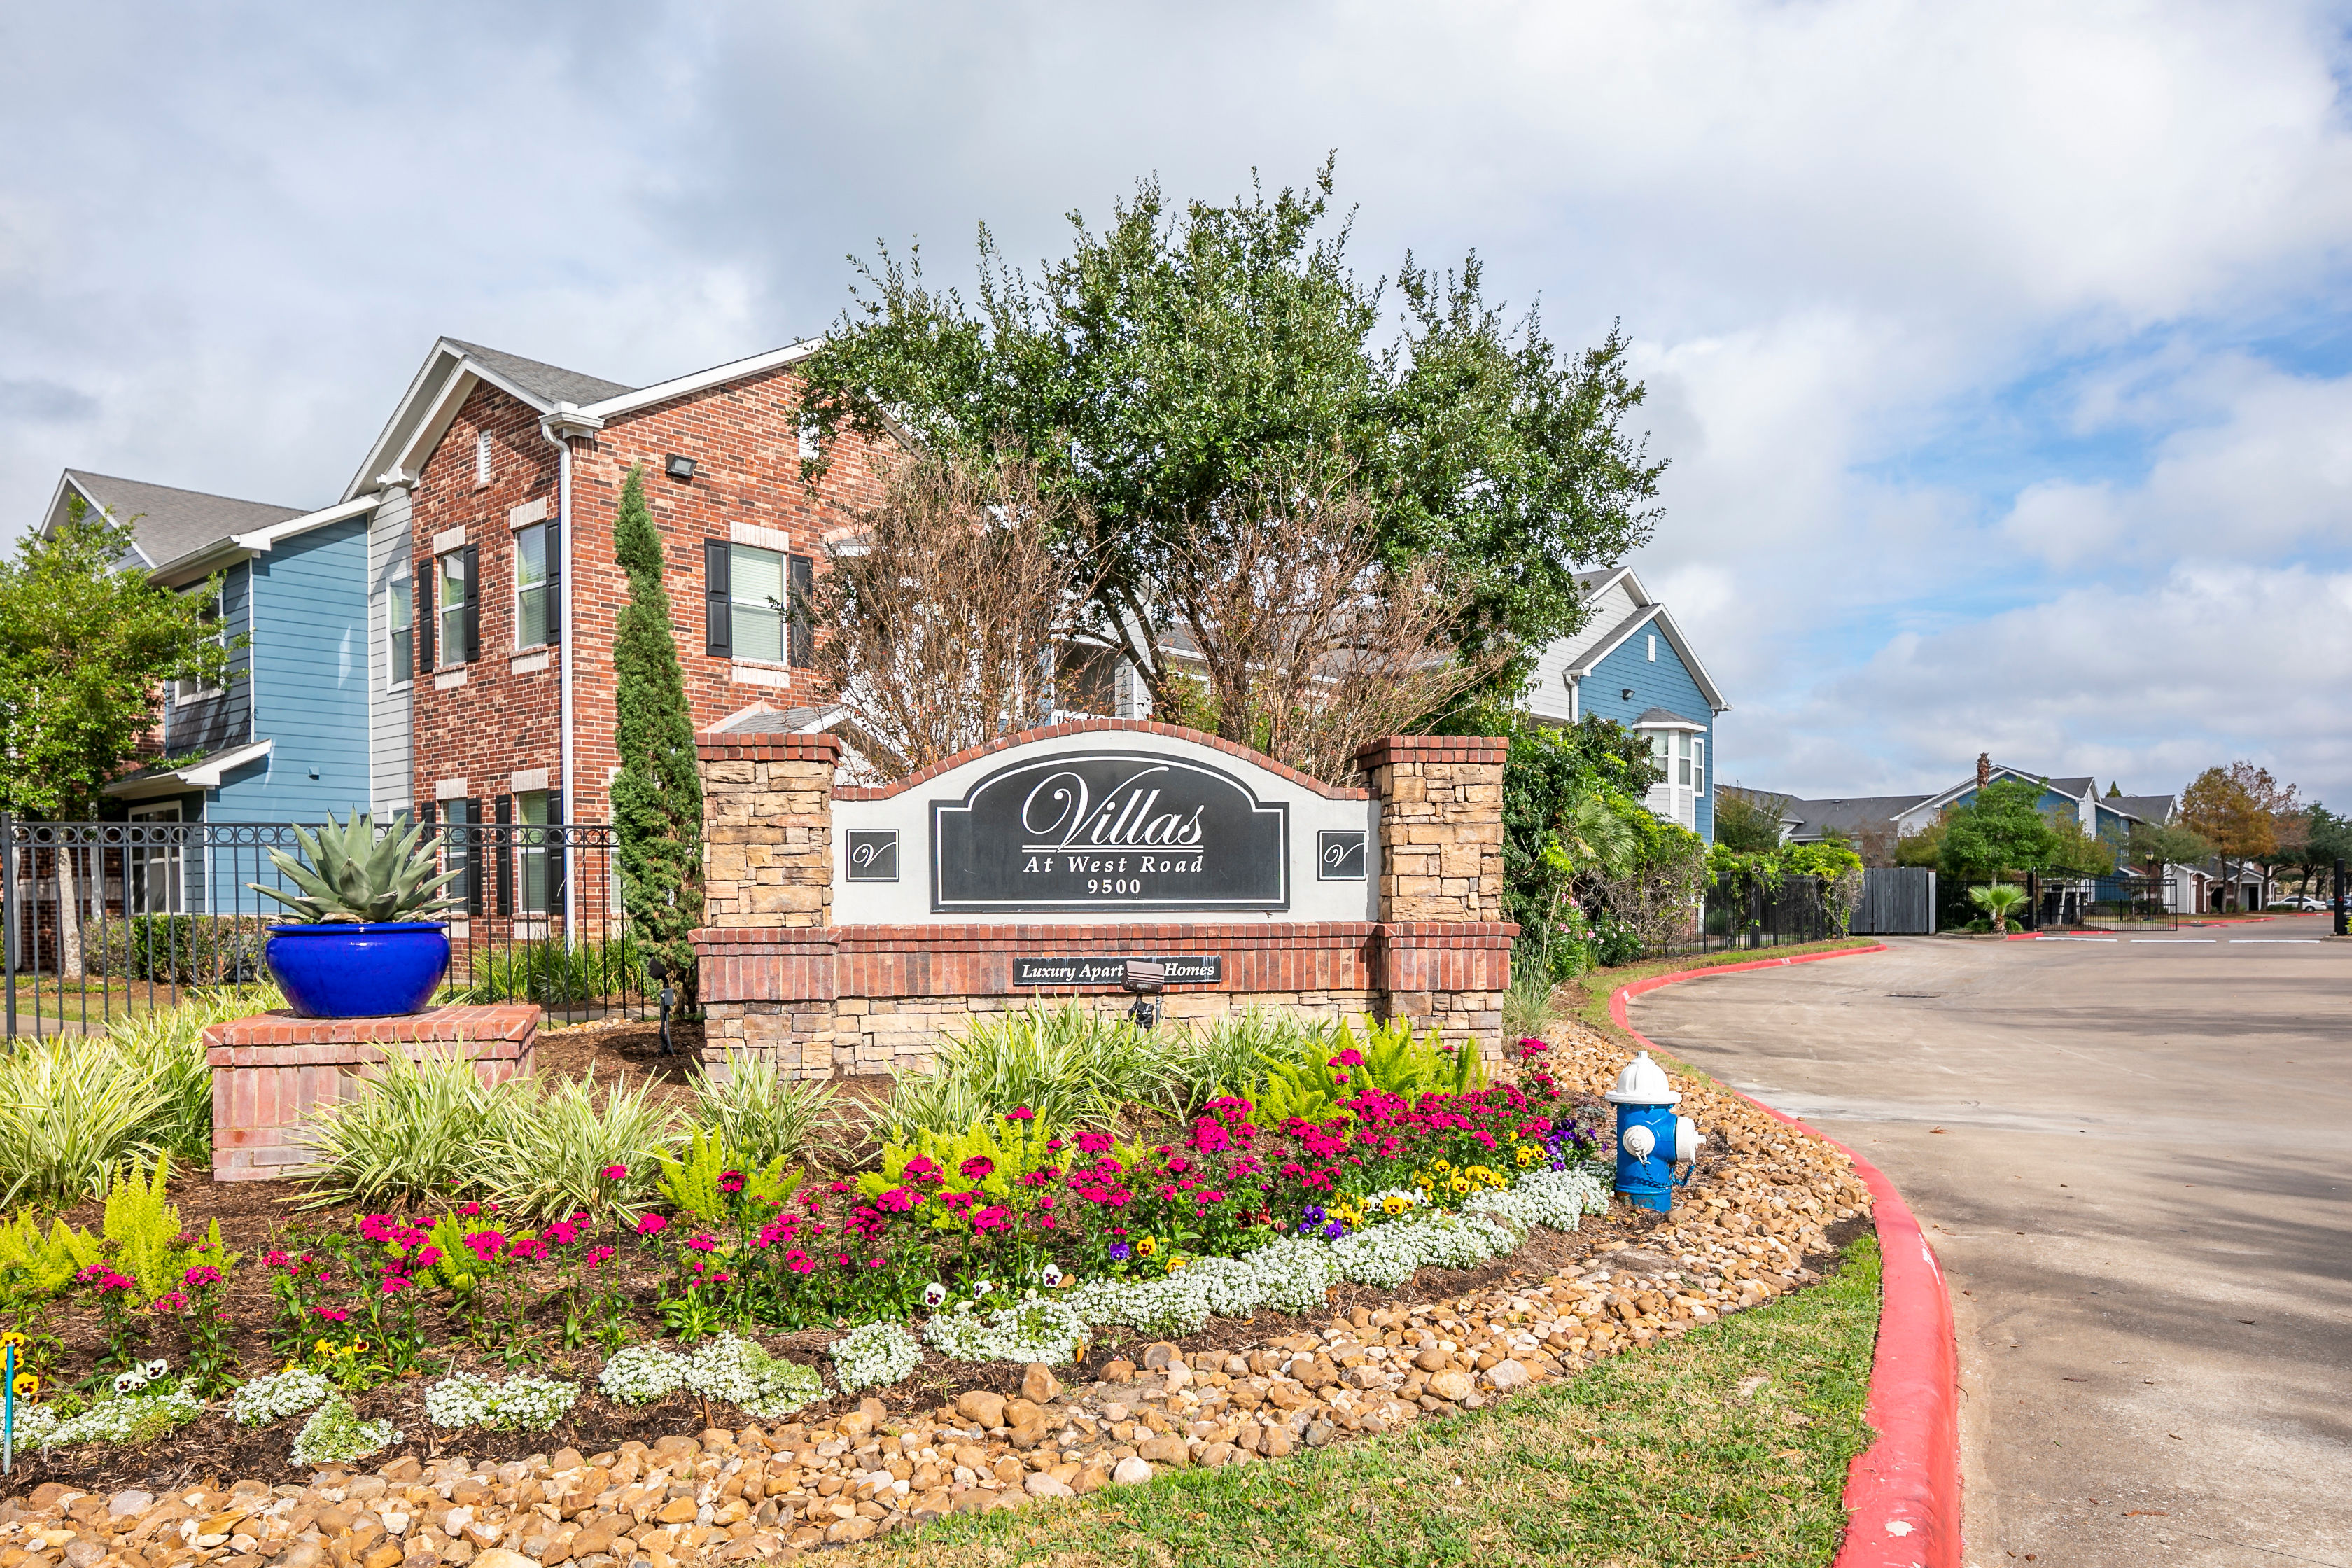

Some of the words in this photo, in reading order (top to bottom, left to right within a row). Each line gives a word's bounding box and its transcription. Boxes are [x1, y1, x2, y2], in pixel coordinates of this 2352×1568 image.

[1022, 766, 1204, 852] Villas
[853, 842, 897, 868] V
[1023, 856, 1054, 873] At
[1068, 855, 1128, 873] West
[1140, 855, 1203, 873] Road
[1324, 843, 1364, 868] V
[1087, 878, 1140, 894] 9500
[1022, 965, 1077, 981] Luxury
[1079, 963, 1125, 981] Apart
[1164, 962, 1214, 976] Homes
